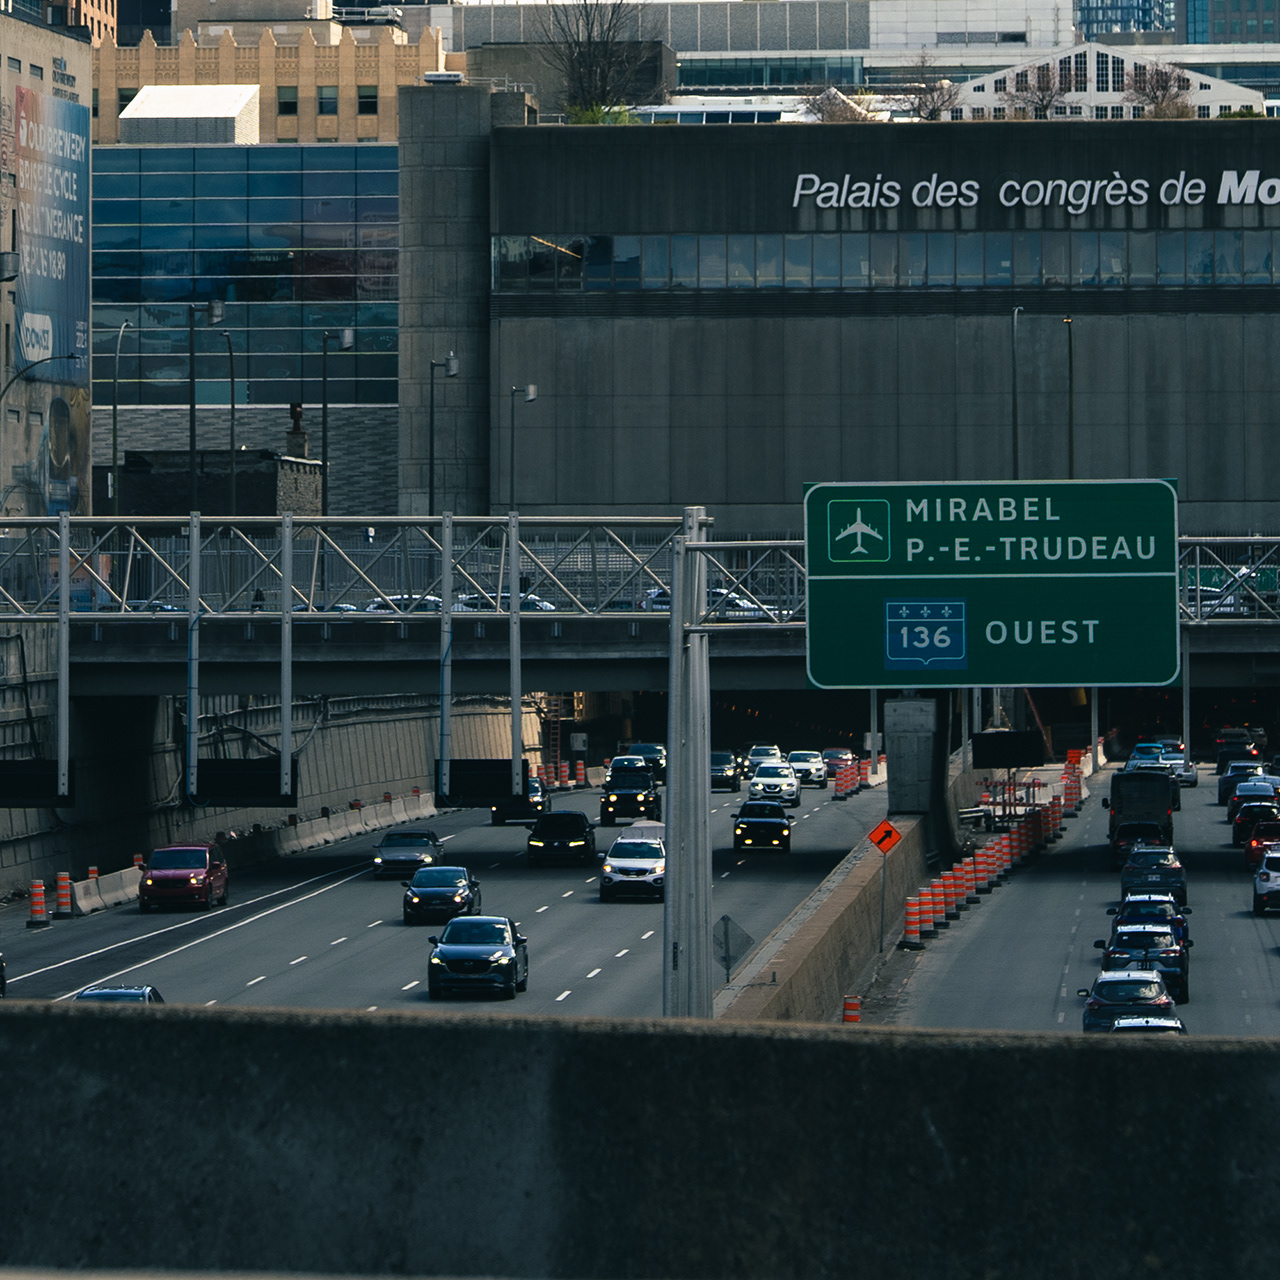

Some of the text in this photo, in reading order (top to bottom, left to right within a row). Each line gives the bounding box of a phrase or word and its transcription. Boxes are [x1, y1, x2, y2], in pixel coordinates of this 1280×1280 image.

[28, 121, 86, 163] OLD BREWERY
[53, 168, 77, 202] CYCLE
[792, 173, 901, 208] Palais
[911, 173, 980, 208] des
[999, 170, 1150, 215] congrès
[1159, 170, 1206, 206] de
[48, 250, 66, 280] 1889
[906, 497, 1060, 522] MIRABEL
[906, 535, 1155, 562] P.-E.-TRUDEAU
[900, 626, 951, 648] 136
[985, 620, 1100, 645] OUEST
